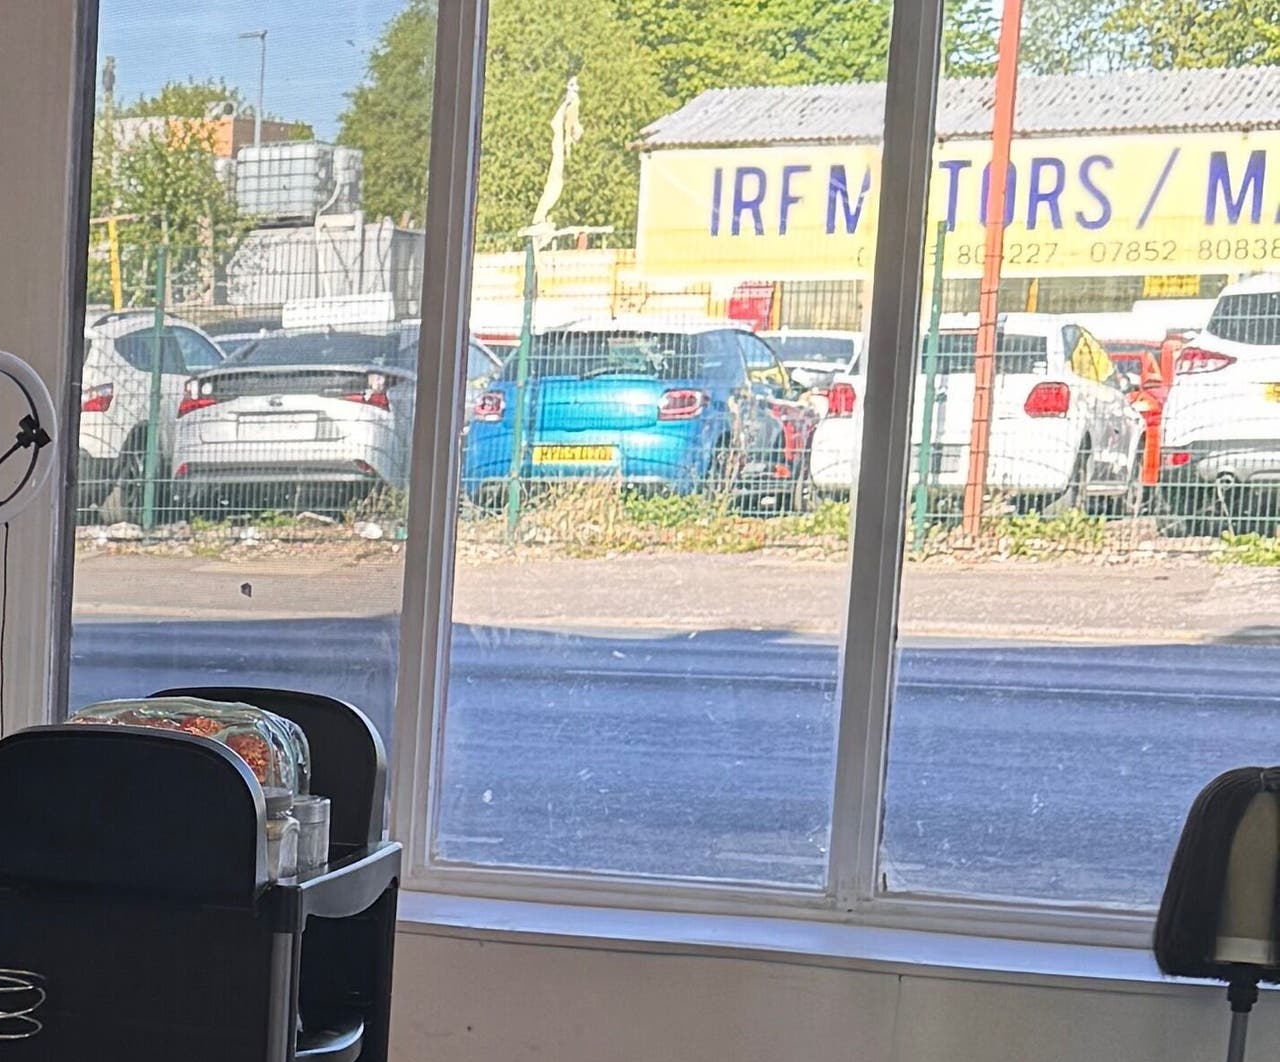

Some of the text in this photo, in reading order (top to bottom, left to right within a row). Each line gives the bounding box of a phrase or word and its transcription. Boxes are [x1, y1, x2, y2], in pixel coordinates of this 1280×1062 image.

[710, 163, 812, 237] IRF
[825, 154, 1115, 235] MTORS
[1204, 149, 1280, 226] M
[957, 242, 1059, 266] 80227
[1089, 239, 1177, 263] 07852
